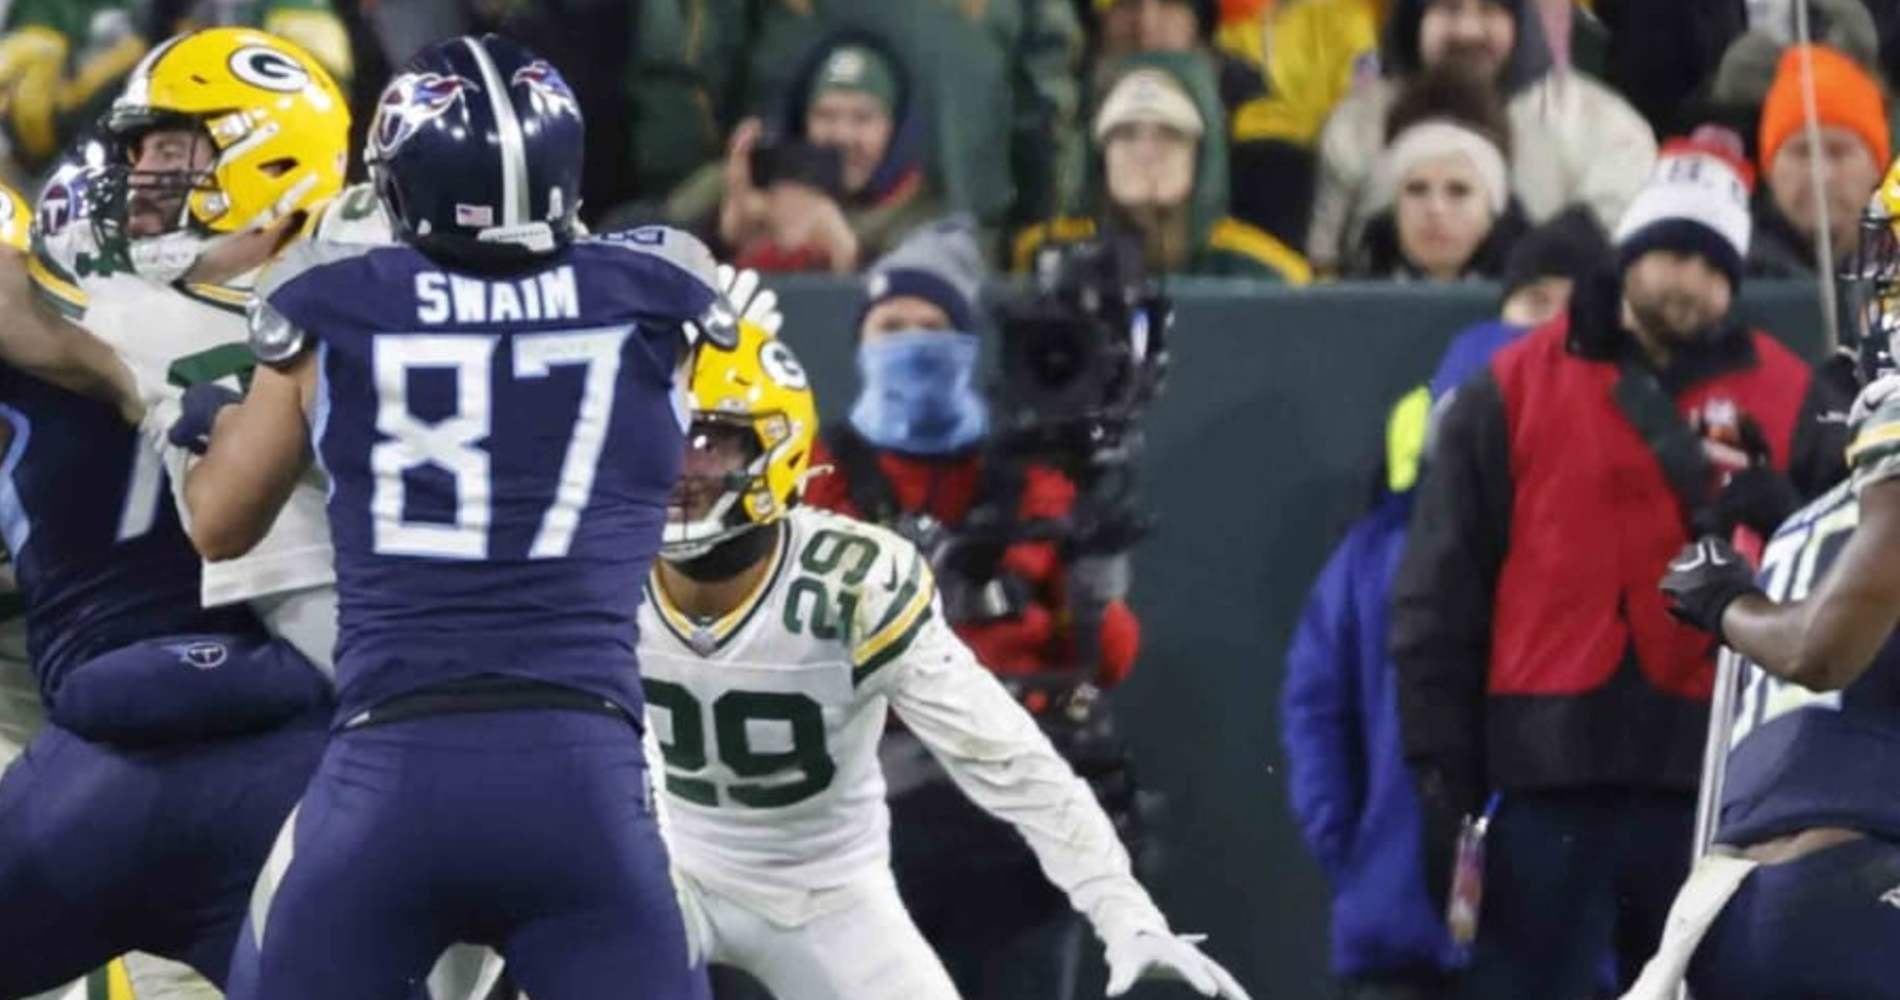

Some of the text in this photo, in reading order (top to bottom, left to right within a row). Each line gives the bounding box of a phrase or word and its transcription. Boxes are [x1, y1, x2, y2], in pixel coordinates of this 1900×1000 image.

[415, 265, 580, 324] SWAIM
[371, 323, 637, 560] 87
[782, 528, 881, 647] 29
[641, 677, 837, 810] 29
